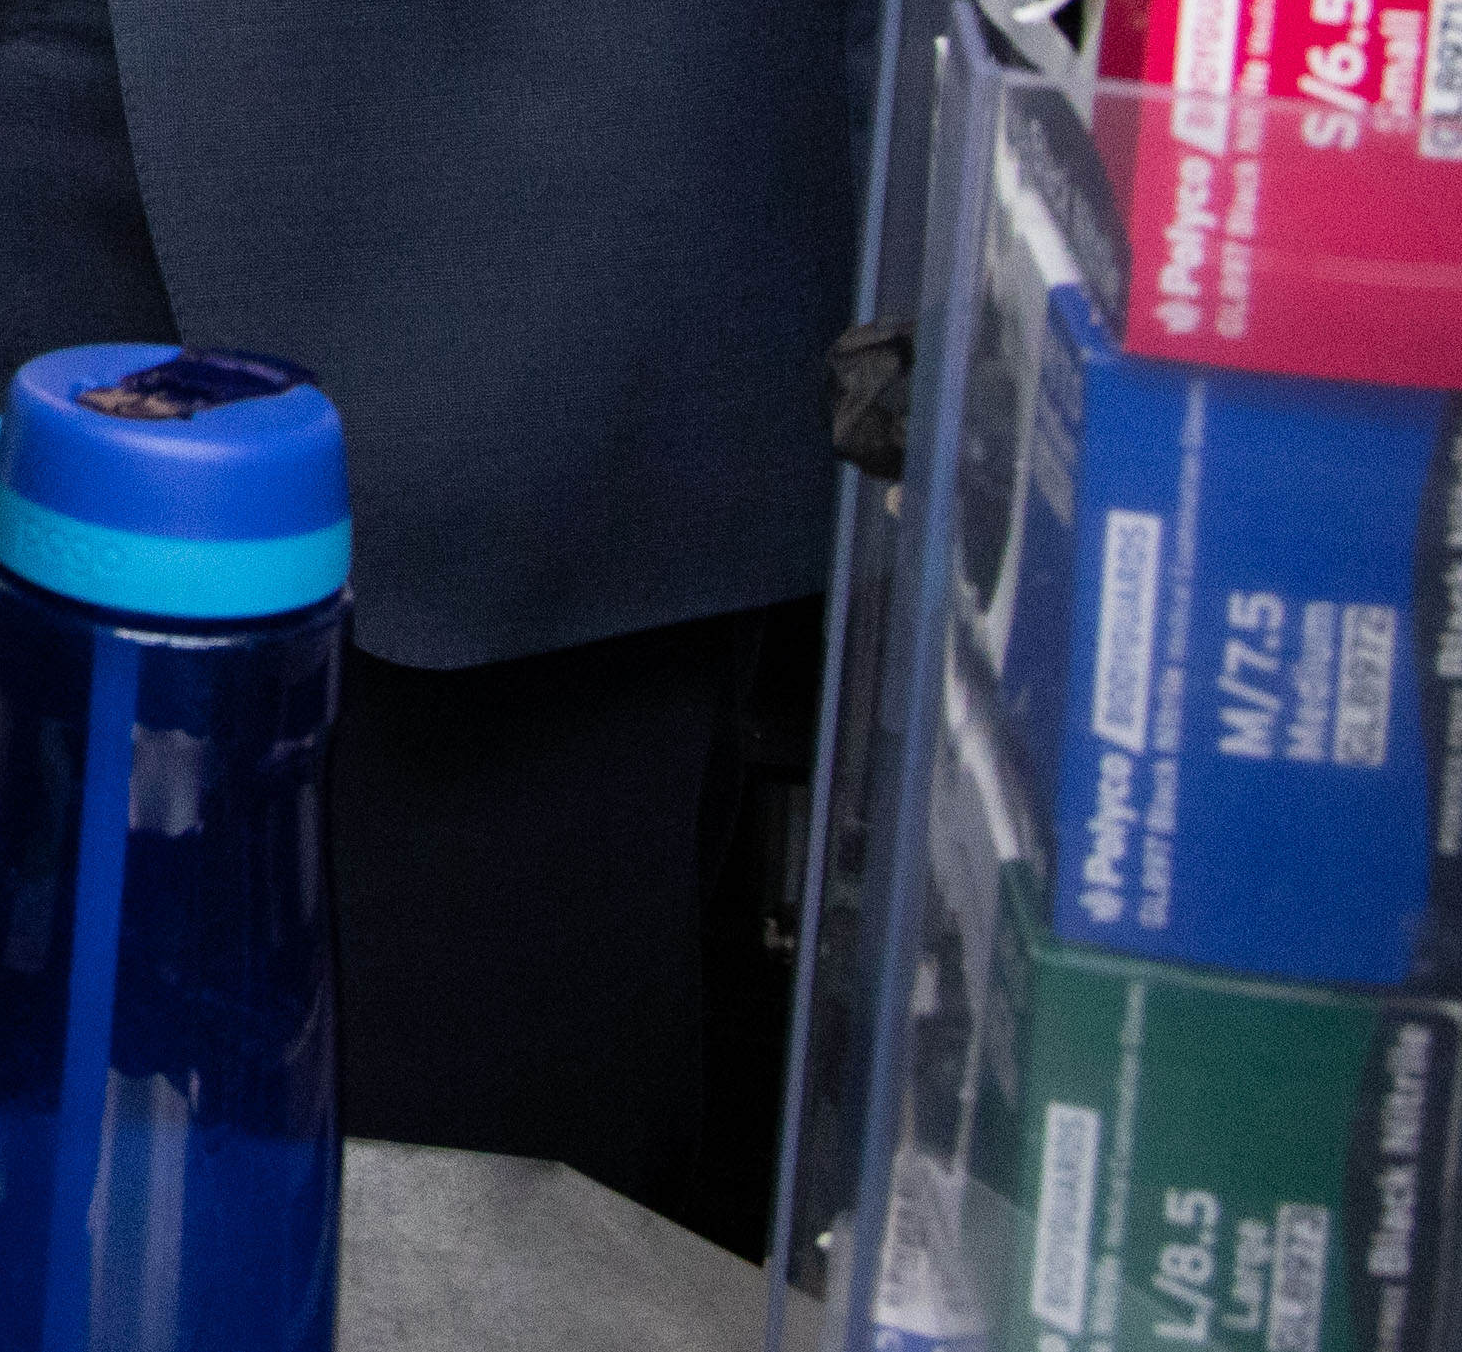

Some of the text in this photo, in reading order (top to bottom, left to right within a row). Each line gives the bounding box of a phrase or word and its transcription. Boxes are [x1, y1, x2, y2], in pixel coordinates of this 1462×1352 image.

[1372, 8, 1424, 134] Small
[1160, 152, 1217, 295] Polyco
[1211, 589, 1288, 758] M/7.5
[1286, 598, 1340, 762] Medium
[1083, 752, 1140, 886] Polyco
[1379, 1021, 1433, 1155] Nitrile
[1149, 1185, 1227, 1343] L/8.5
[1226, 1216, 1276, 1331] Large
[1367, 1162, 1420, 1278] Black
